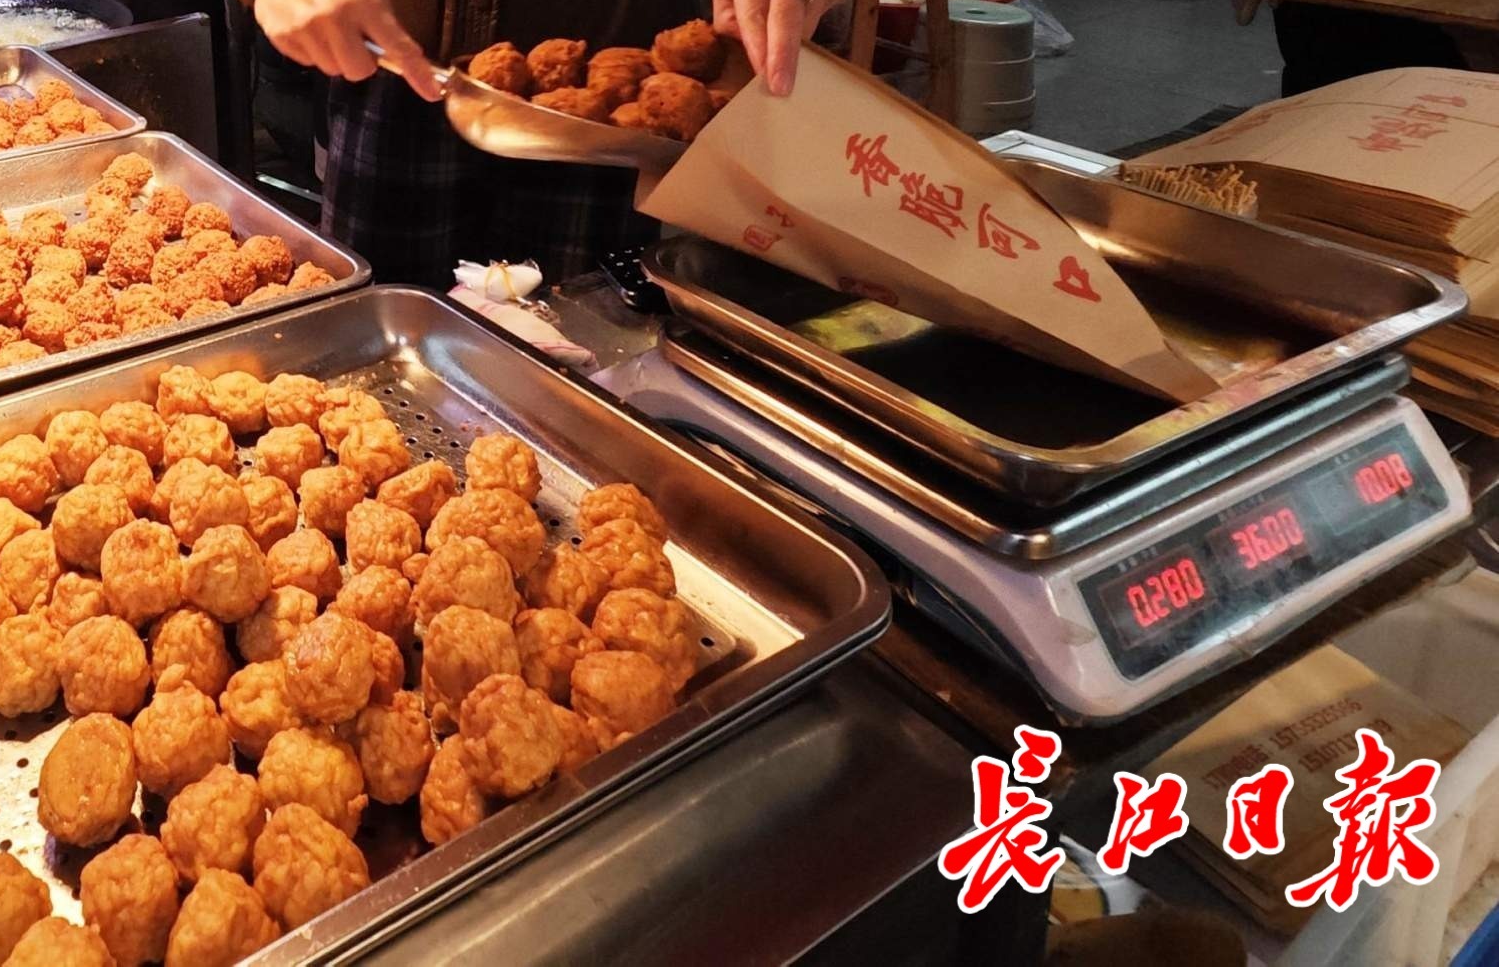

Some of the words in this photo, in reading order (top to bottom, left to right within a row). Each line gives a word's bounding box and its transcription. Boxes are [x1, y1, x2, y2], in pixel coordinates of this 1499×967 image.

[845, 132, 1102, 303] 香脆可口
[1232, 507, 1305, 570] 36.00
[1125, 557, 1205, 628] 0.280
